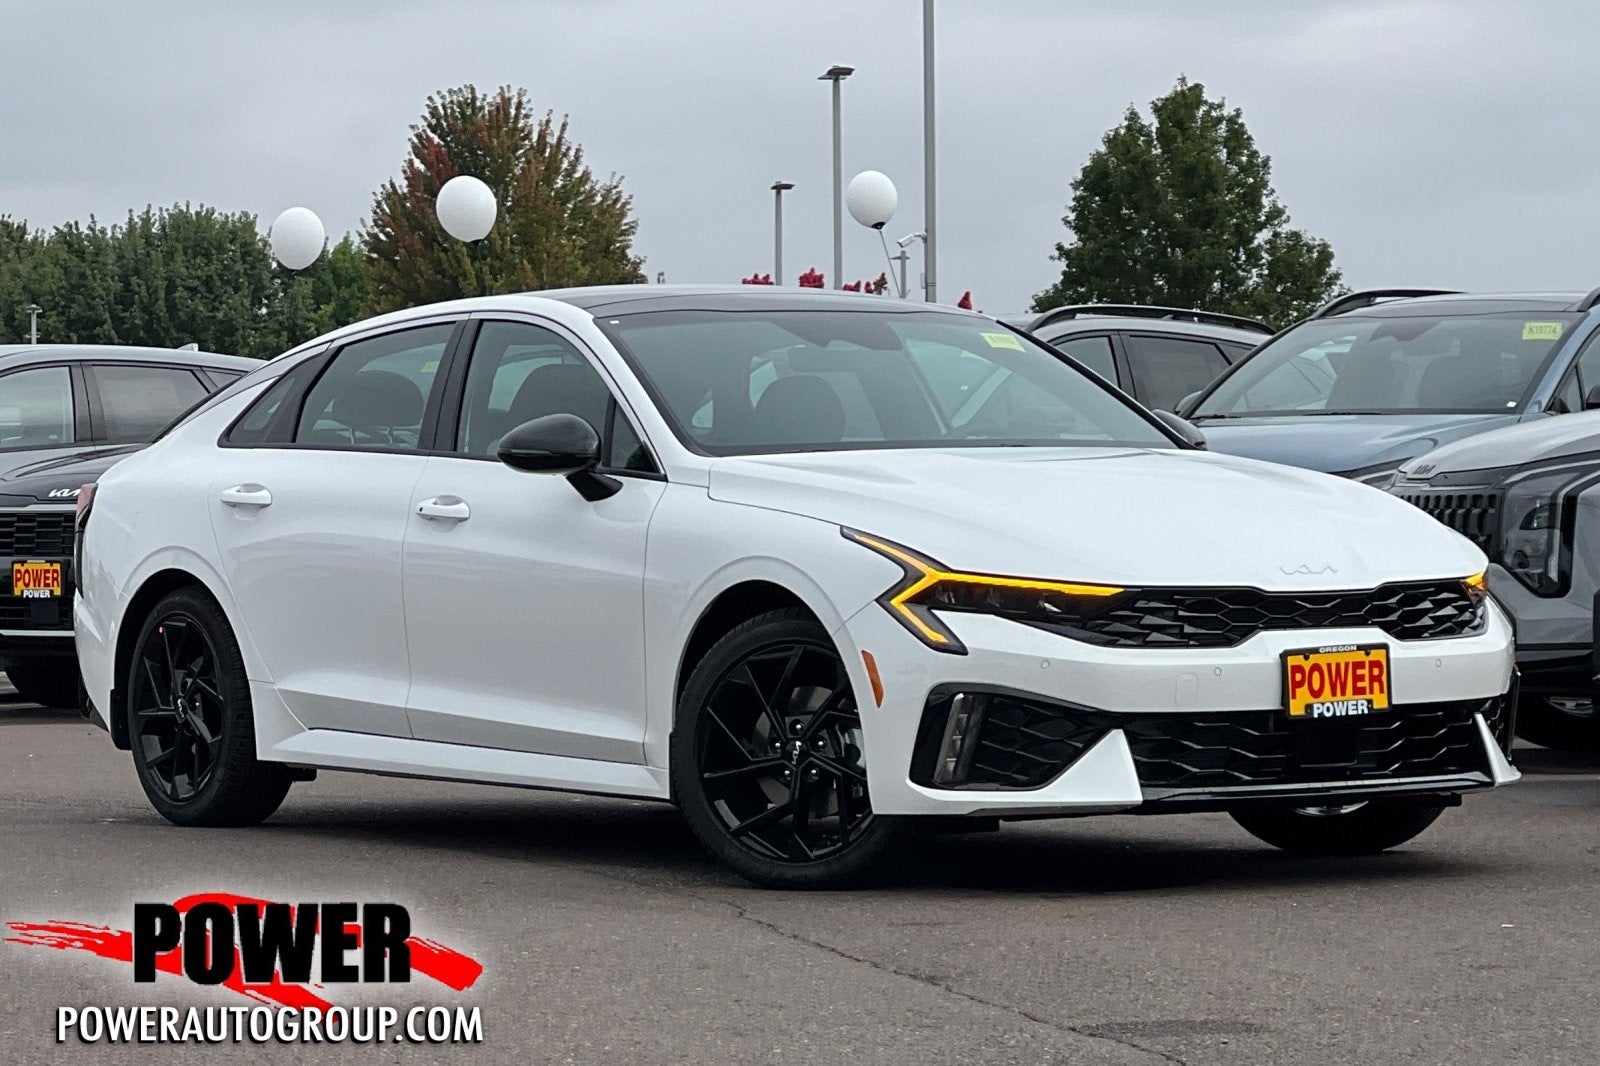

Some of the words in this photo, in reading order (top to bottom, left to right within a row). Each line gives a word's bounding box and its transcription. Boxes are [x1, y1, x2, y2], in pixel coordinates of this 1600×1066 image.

[14, 568, 60, 588] POWER
[23, 589, 51, 599] POWER
[1319, 645, 1358, 654] OREGON
[1290, 659, 1385, 700] POWER
[1313, 700, 1369, 718] POWER
